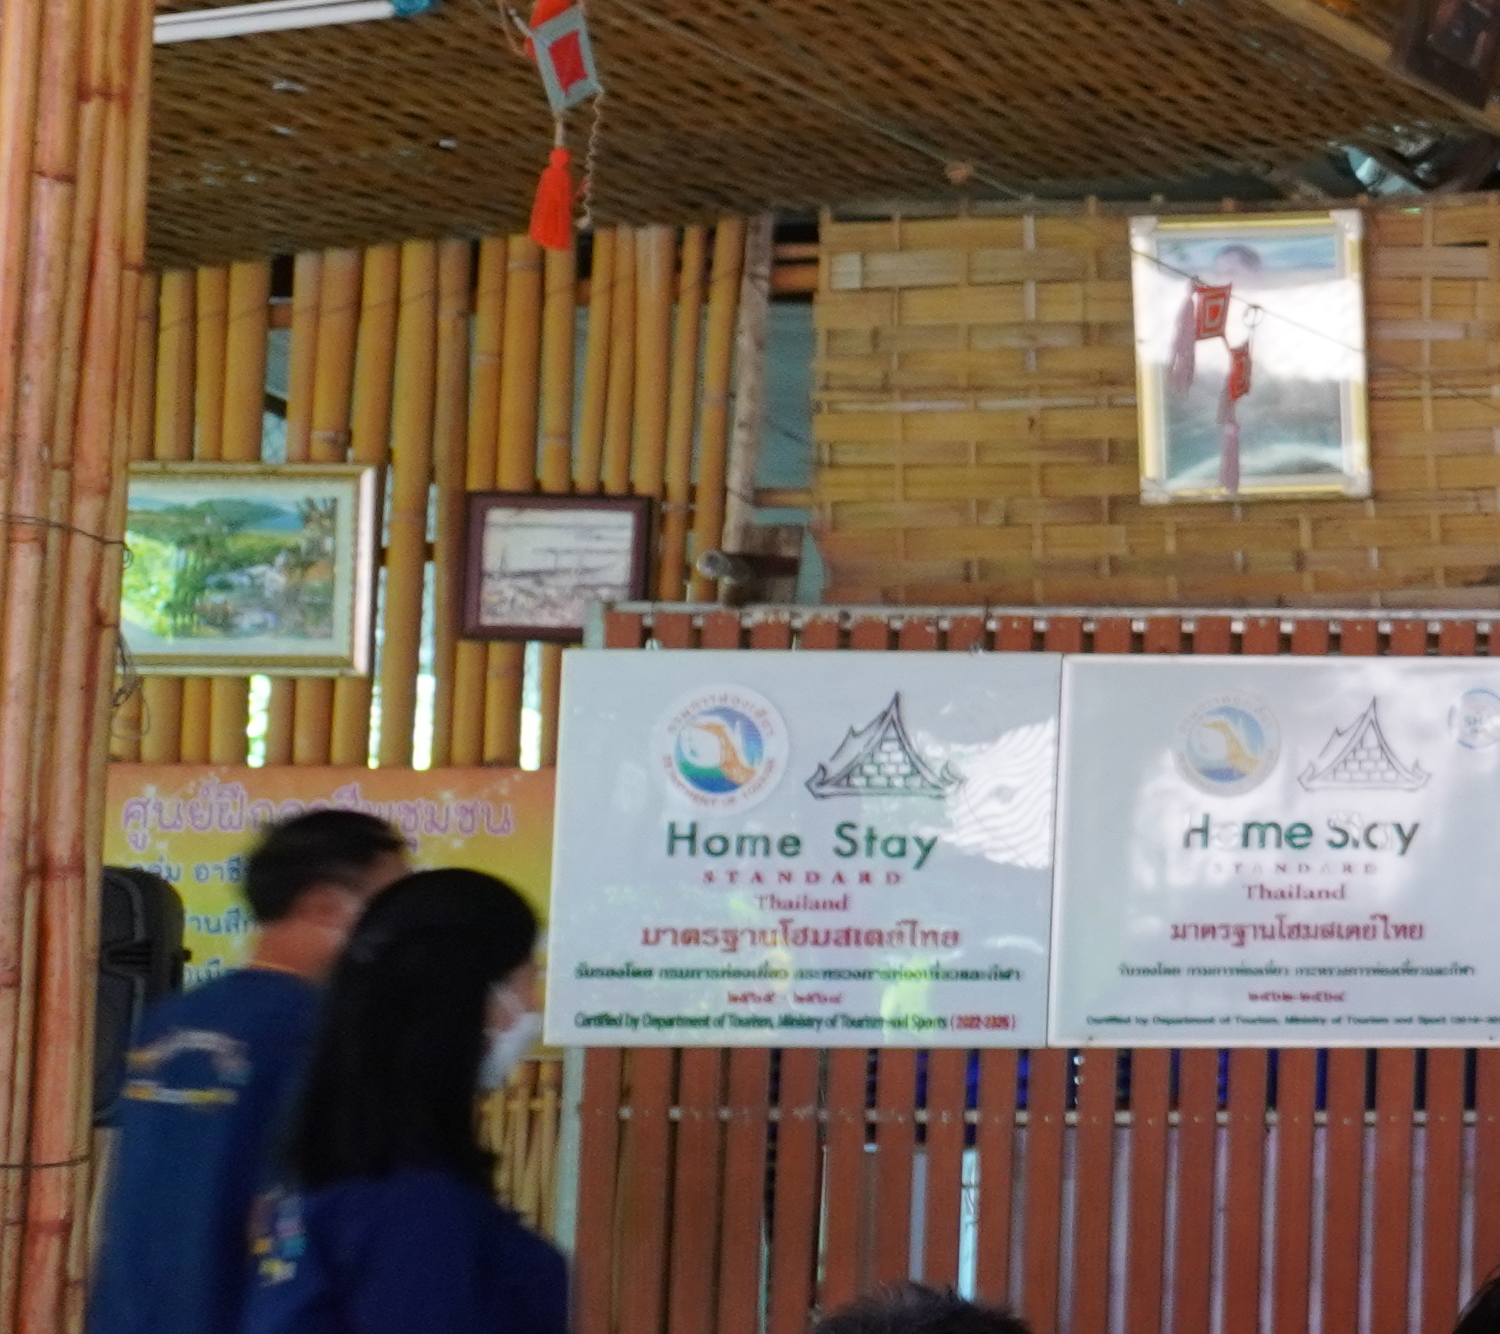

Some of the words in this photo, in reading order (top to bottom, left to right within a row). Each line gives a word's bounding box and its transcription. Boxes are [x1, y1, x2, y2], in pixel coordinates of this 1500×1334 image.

[666, 820, 802, 858] Home
[832, 820, 939, 870] Stay
[702, 869, 903, 885] STANDARD
[757, 893, 851, 911] Thailand
[1244, 884, 1346, 901] Thailand
[641, 919, 961, 953] มาตรฐานโฮมสเตย์ไทย
[1170, 914, 1425, 947] มาตรฐานโฮมสเตย์ไทย
